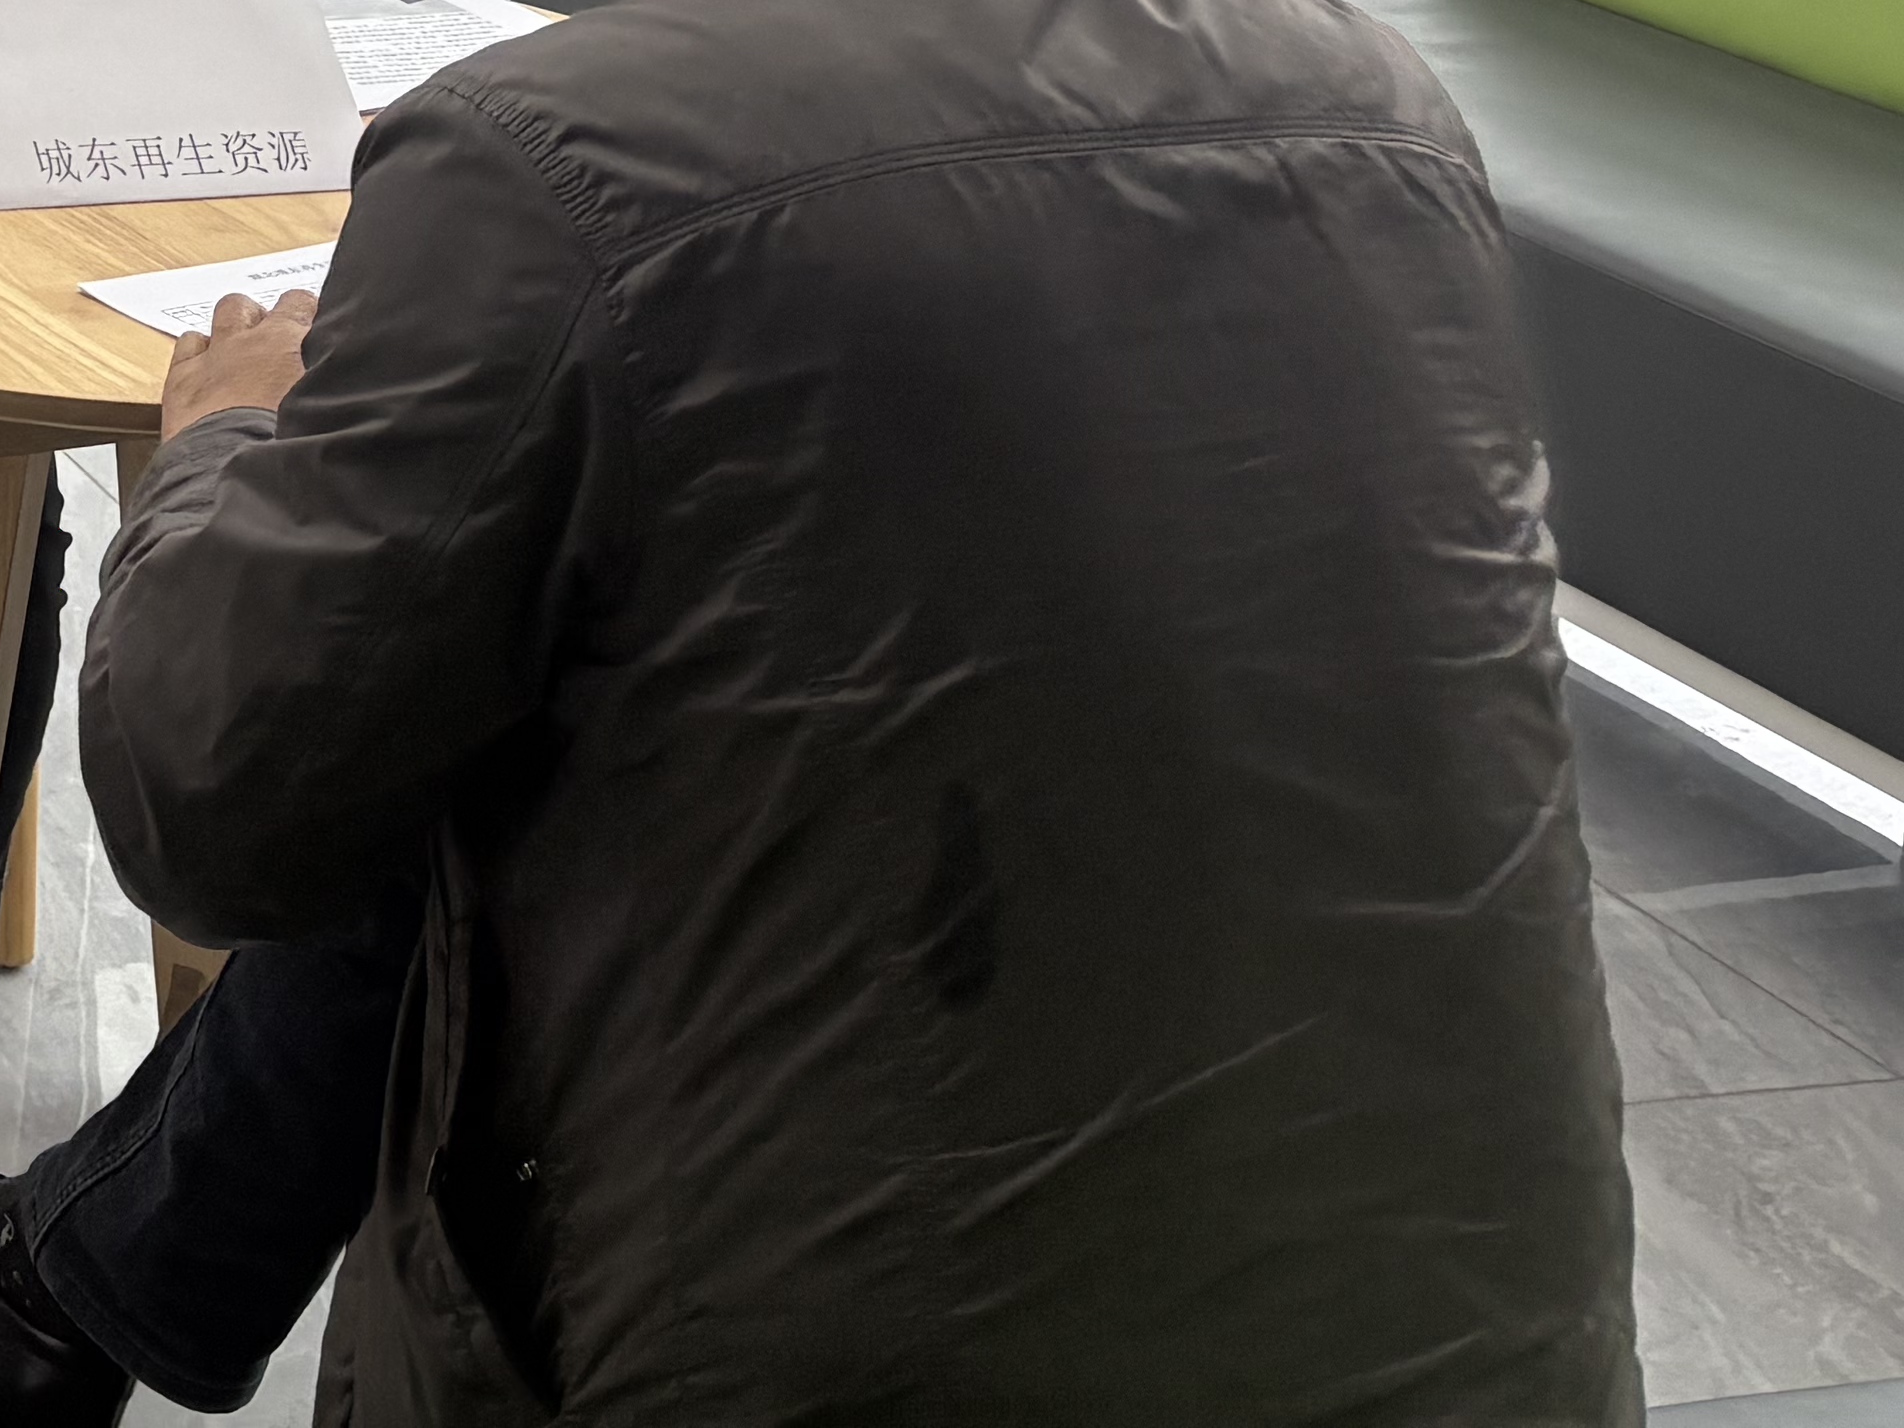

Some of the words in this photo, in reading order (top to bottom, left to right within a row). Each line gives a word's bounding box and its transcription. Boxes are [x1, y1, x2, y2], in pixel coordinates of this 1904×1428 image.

[33, 130, 312, 184] 城东再生资源
